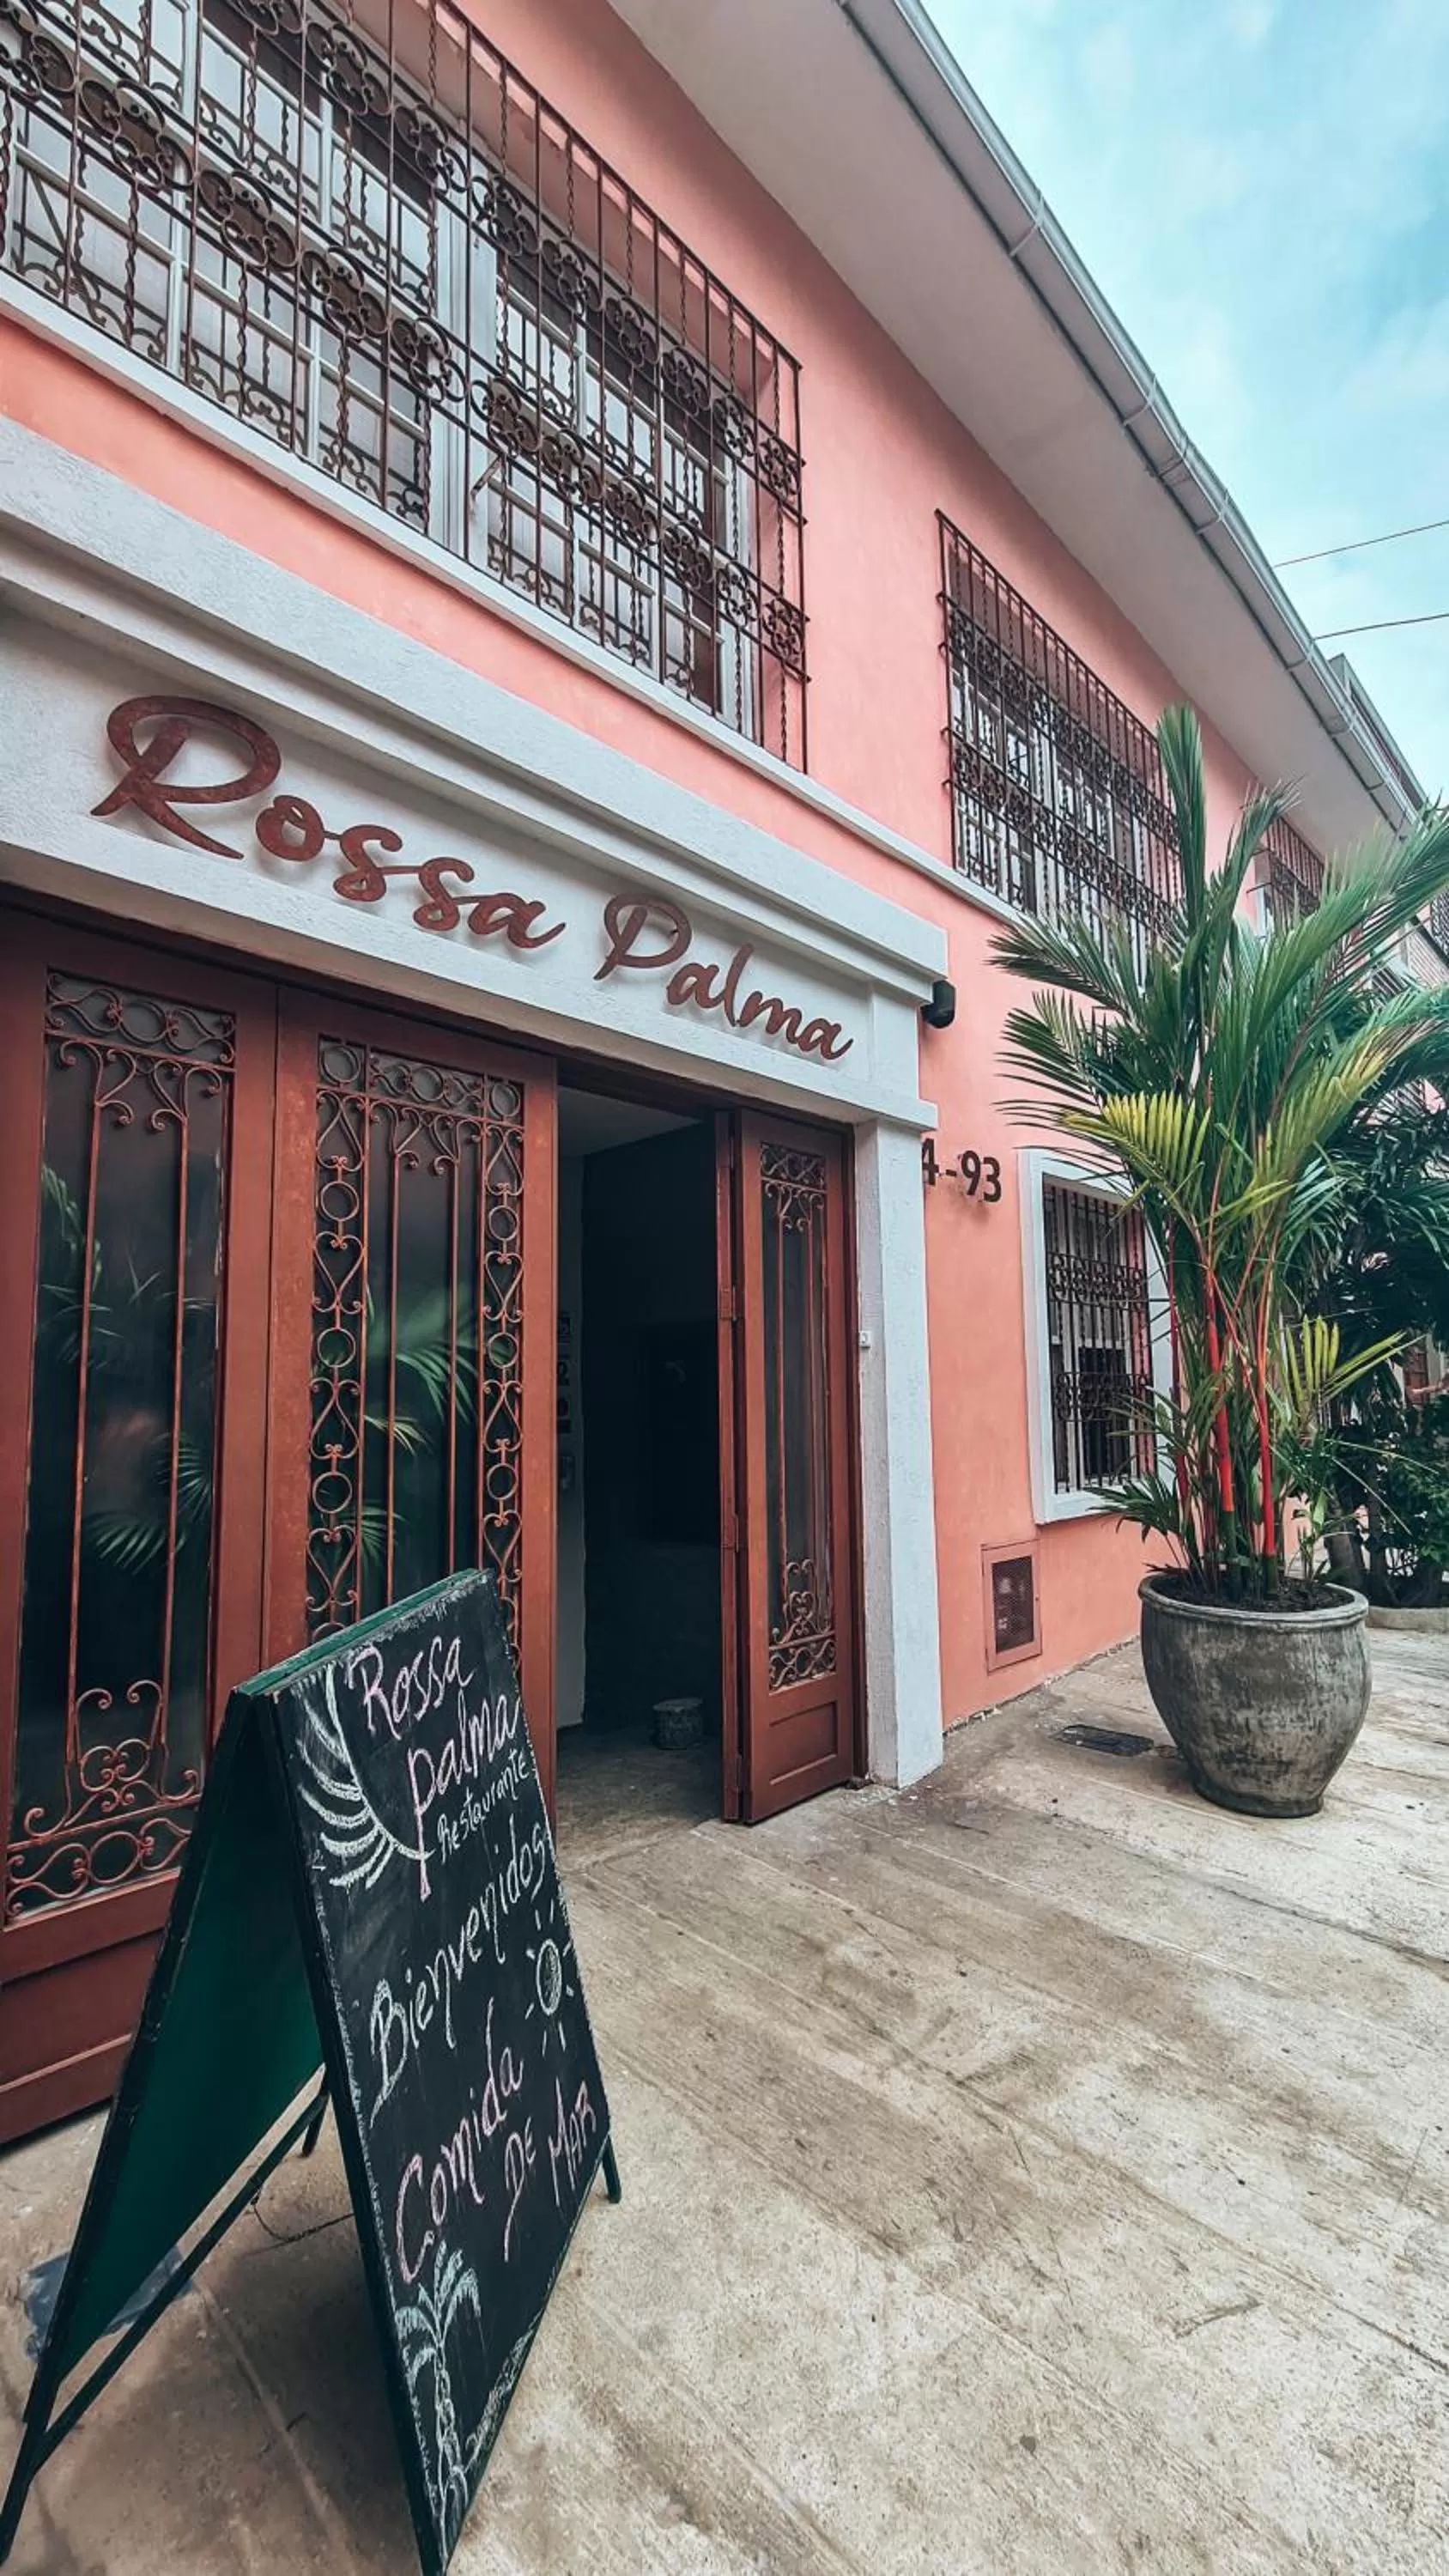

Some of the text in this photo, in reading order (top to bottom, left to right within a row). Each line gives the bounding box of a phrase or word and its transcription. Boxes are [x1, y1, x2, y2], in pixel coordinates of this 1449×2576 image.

[89, 694, 854, 1061] Rossa Palma
[347, 1635, 476, 1741] Rossa
[369, 1813, 547, 2129] Bienvenidos
[395, 1996, 524, 2285] Comida
